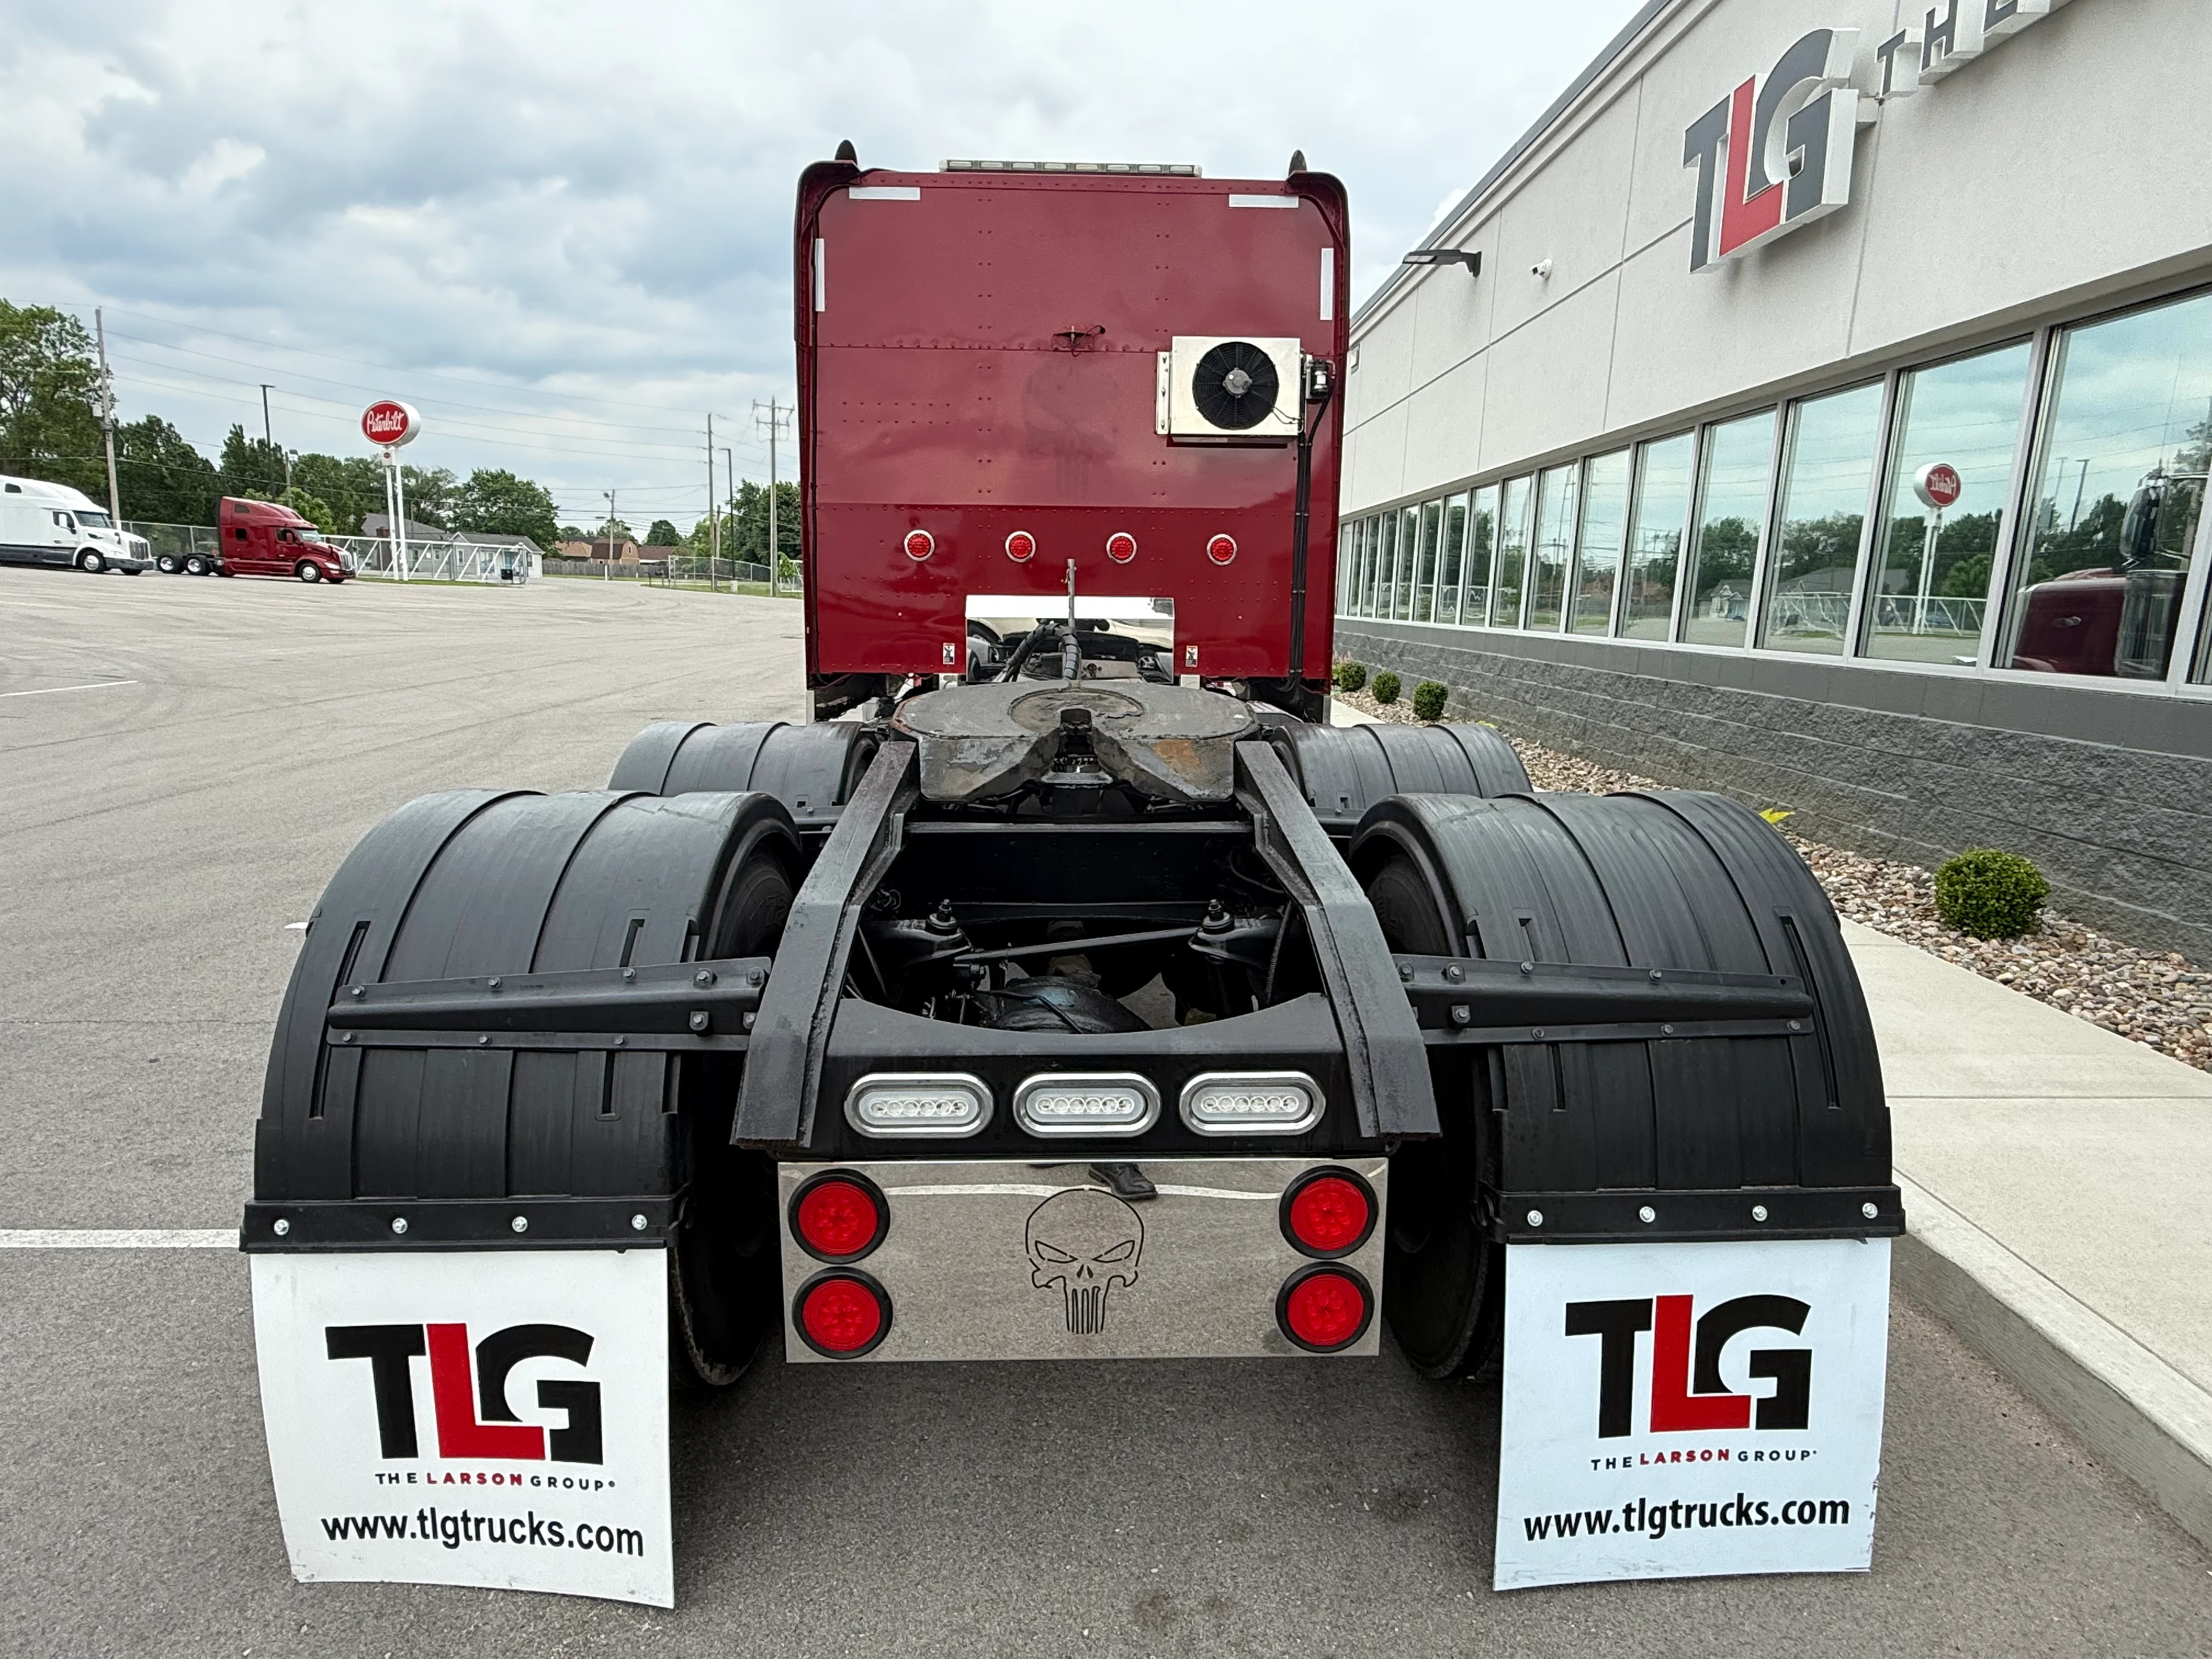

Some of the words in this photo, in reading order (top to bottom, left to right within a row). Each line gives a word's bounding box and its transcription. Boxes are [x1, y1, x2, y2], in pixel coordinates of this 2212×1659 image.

[1682, 29, 1835, 273] TLG
[366, 410, 405, 435] Peterbilt
[1565, 1294, 1813, 1439] TLG
[325, 1323, 603, 1465] TLG
[375, 1472, 417, 1485] THE
[427, 1472, 522, 1486] LARSON
[530, 1475, 604, 1492] GROUP
[1590, 1456, 1632, 1471] THE
[1640, 1449, 1729, 1465] LARSON
[1737, 1449, 1811, 1462] GROUP
[320, 1507, 644, 1557] www.tlgtrucks.com
[1523, 1492, 1850, 1542] www.tlgtrucks.com
